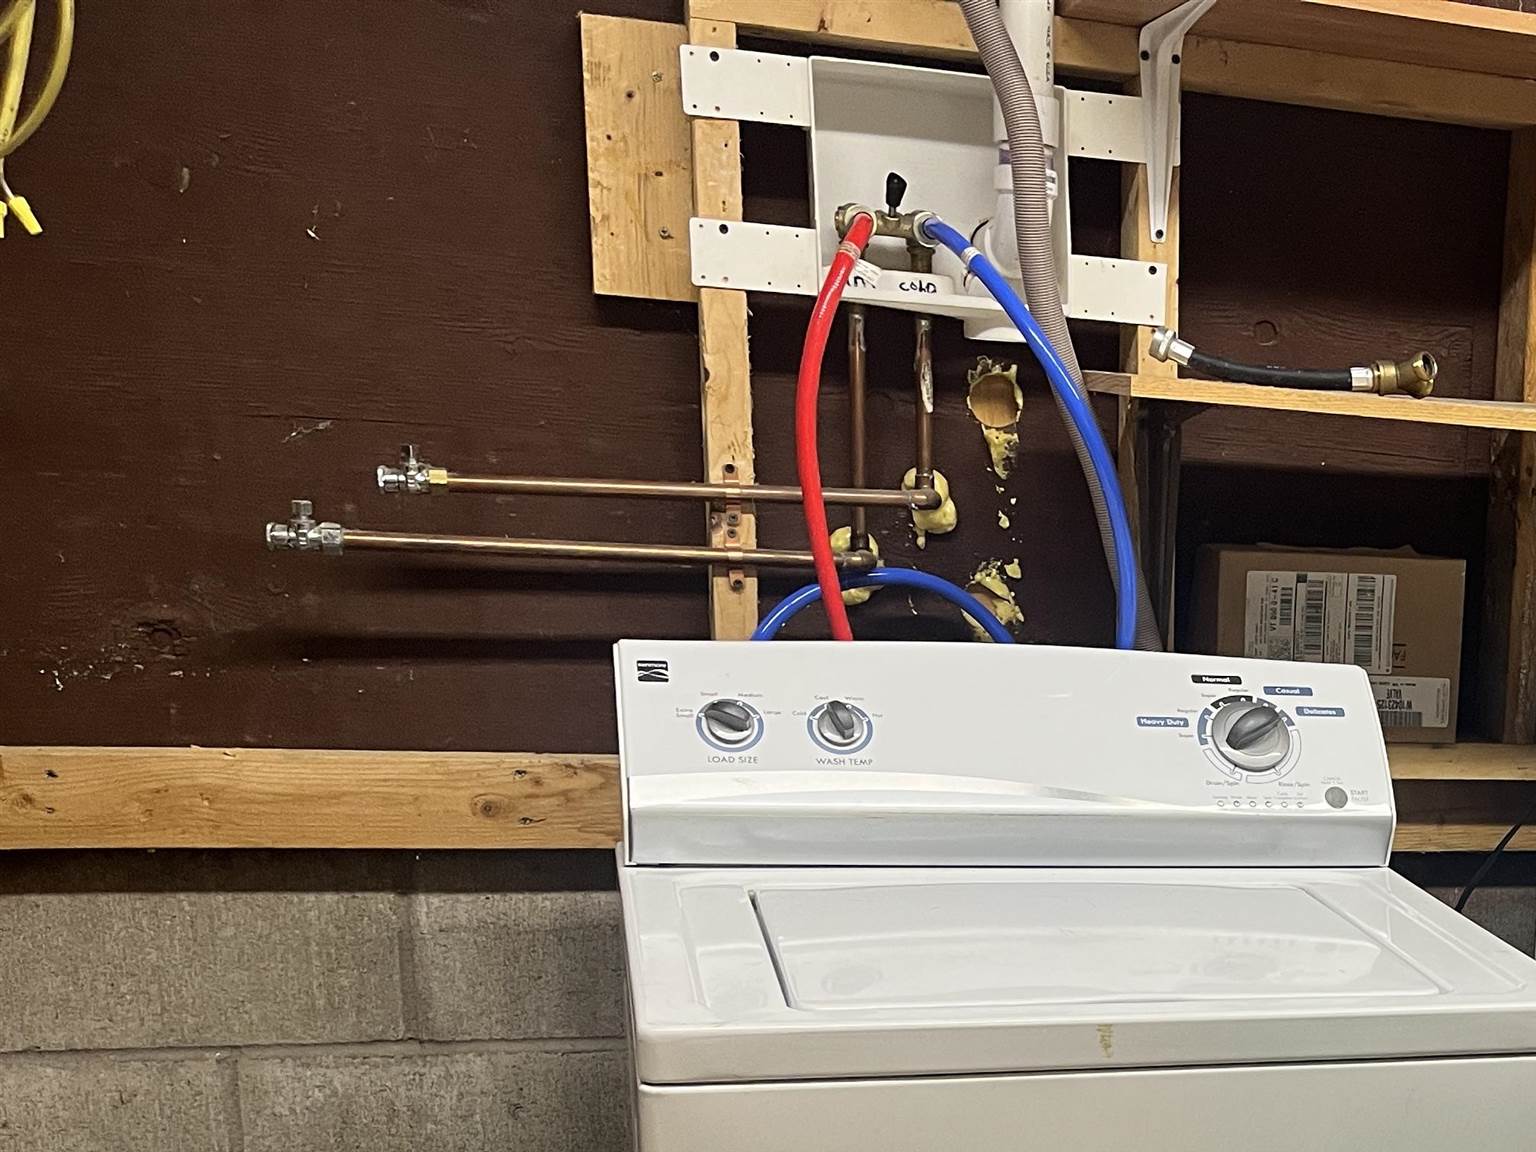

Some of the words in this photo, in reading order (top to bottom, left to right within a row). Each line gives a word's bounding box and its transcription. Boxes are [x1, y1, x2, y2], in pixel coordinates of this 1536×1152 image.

[1275, 687, 1300, 695] Casual
[1303, 707, 1337, 715] Delicates
[1140, 718, 1165, 726] Heavy
[1166, 719, 1184, 727] Duty
[707, 756, 736, 764] LOAD
[738, 756, 759, 764] SIZE
[815, 758, 845, 766] WASH
[847, 758, 873, 766] TEMP
